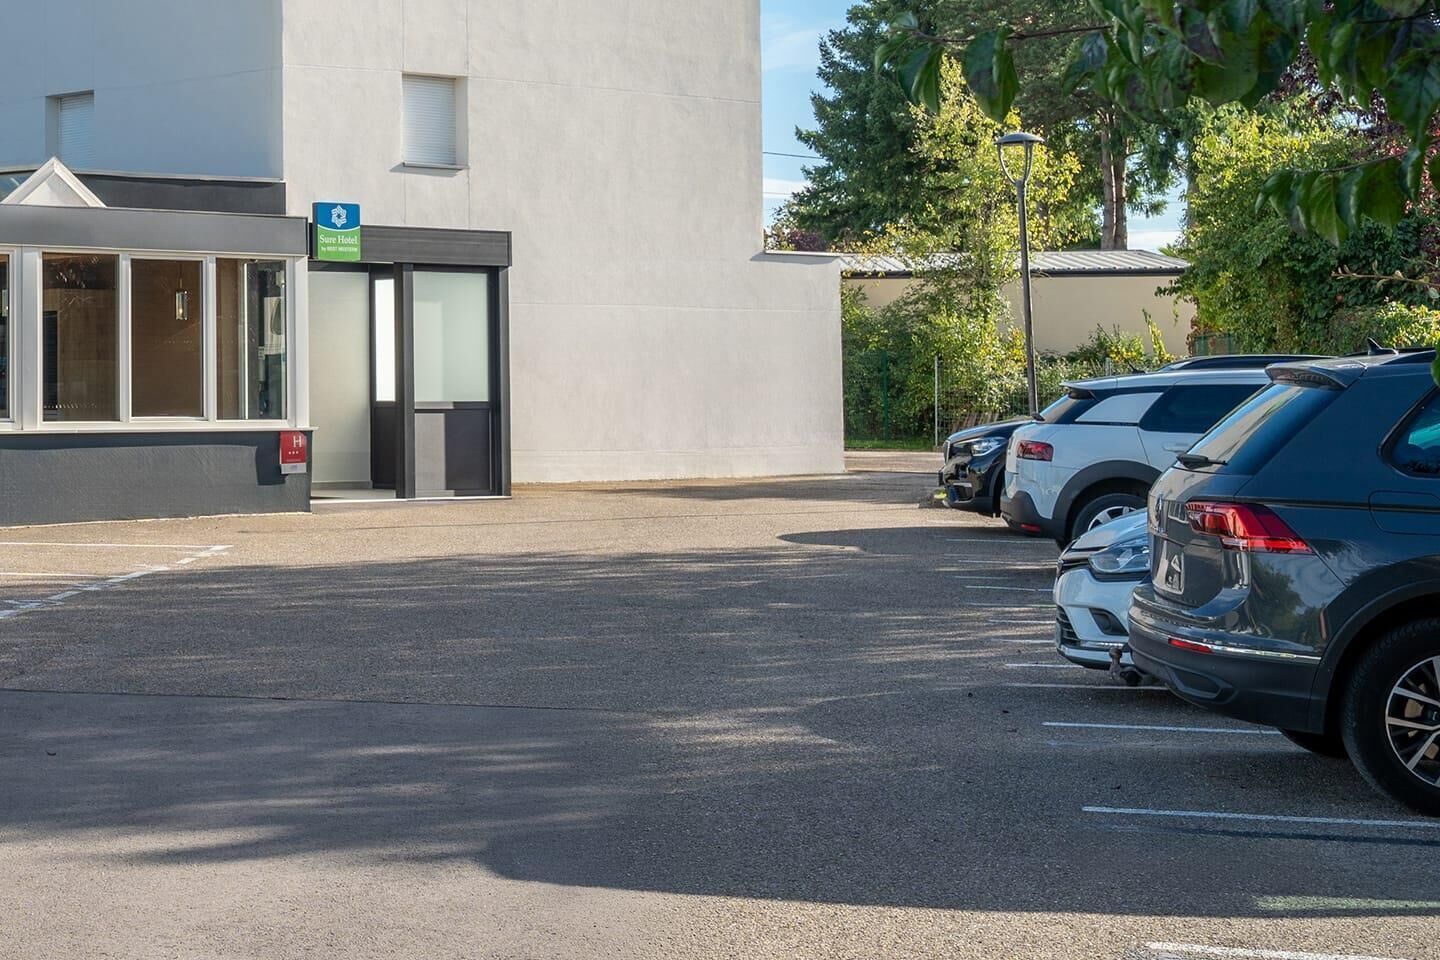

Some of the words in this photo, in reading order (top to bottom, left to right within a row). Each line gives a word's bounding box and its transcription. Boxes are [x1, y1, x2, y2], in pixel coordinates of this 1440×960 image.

[319, 234, 337, 244] Sure
[337, 234, 358, 245] Hotel
[293, 435, 302, 448] H
